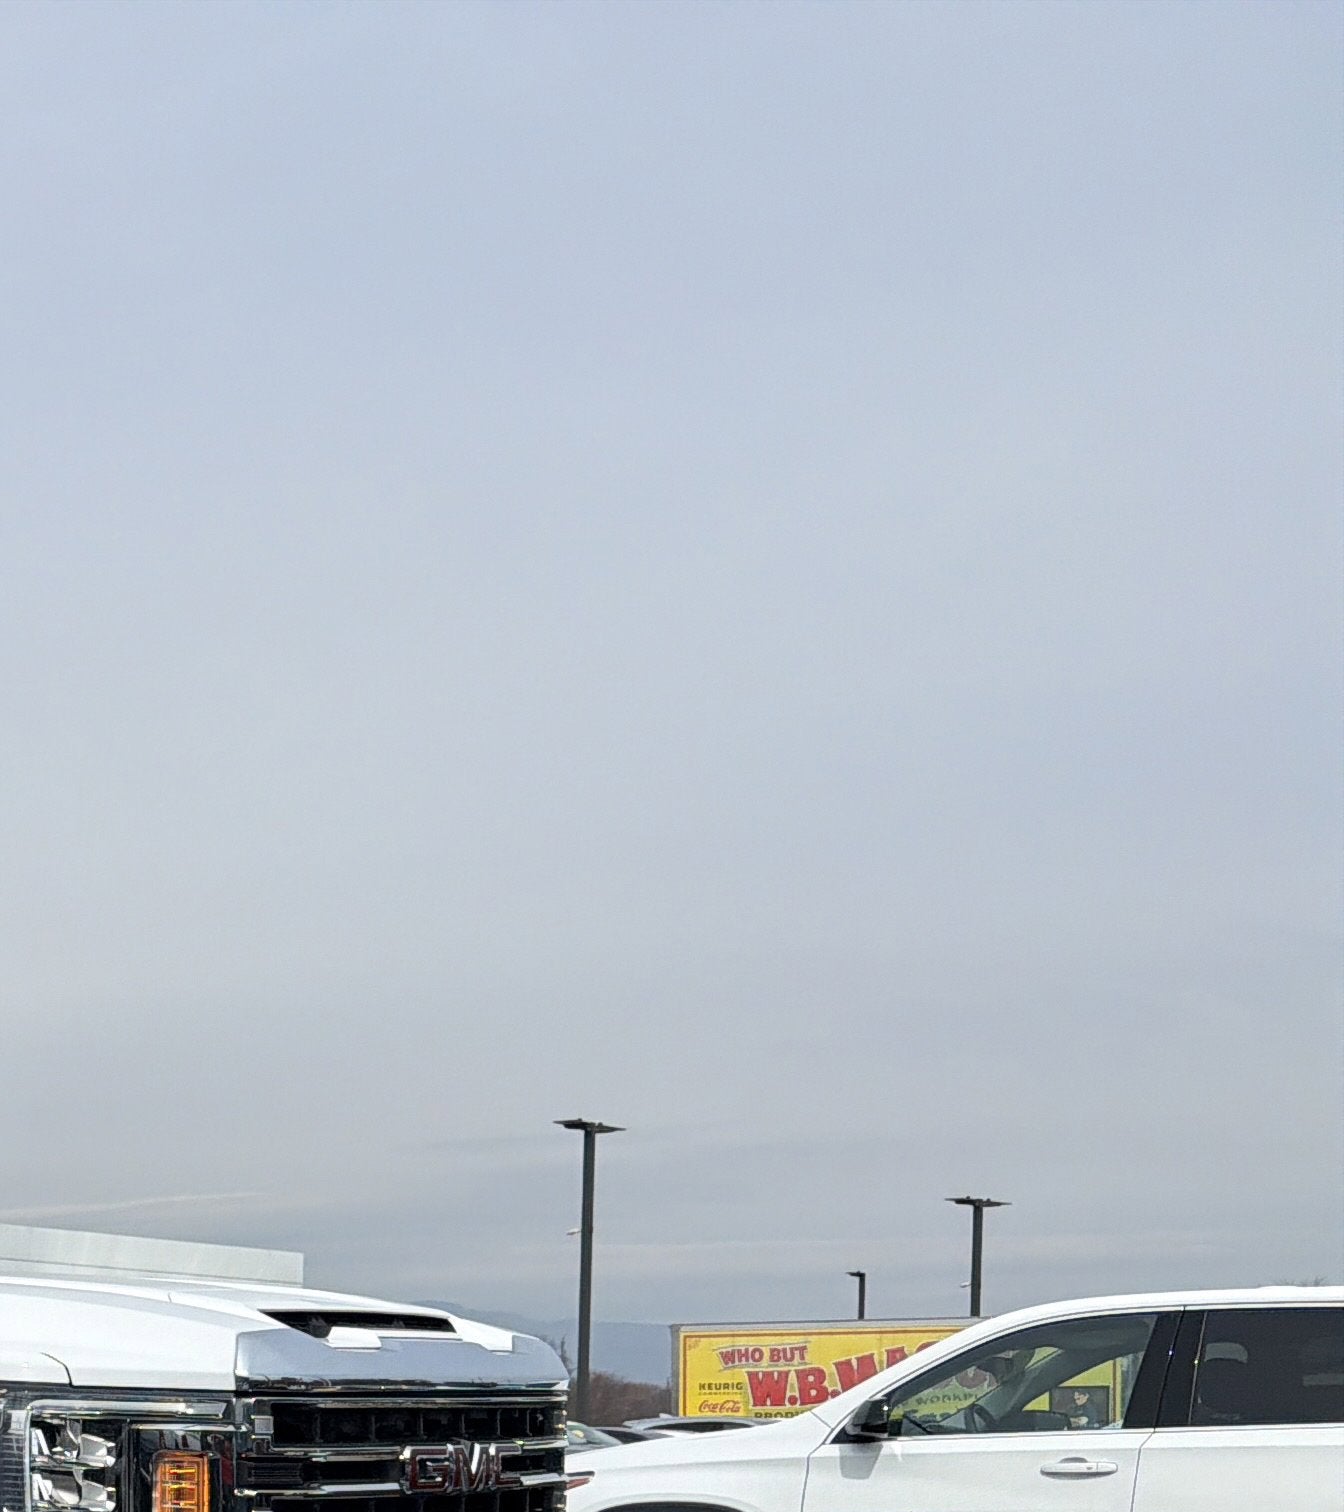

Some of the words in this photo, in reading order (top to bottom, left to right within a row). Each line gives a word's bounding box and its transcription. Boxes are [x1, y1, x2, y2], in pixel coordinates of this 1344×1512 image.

[719, 1347, 763, 1365] WHO
[769, 1345, 807, 1362] BUT
[698, 1382, 744, 1391] KEURIG
[402, 1440, 522, 1494] GMC
